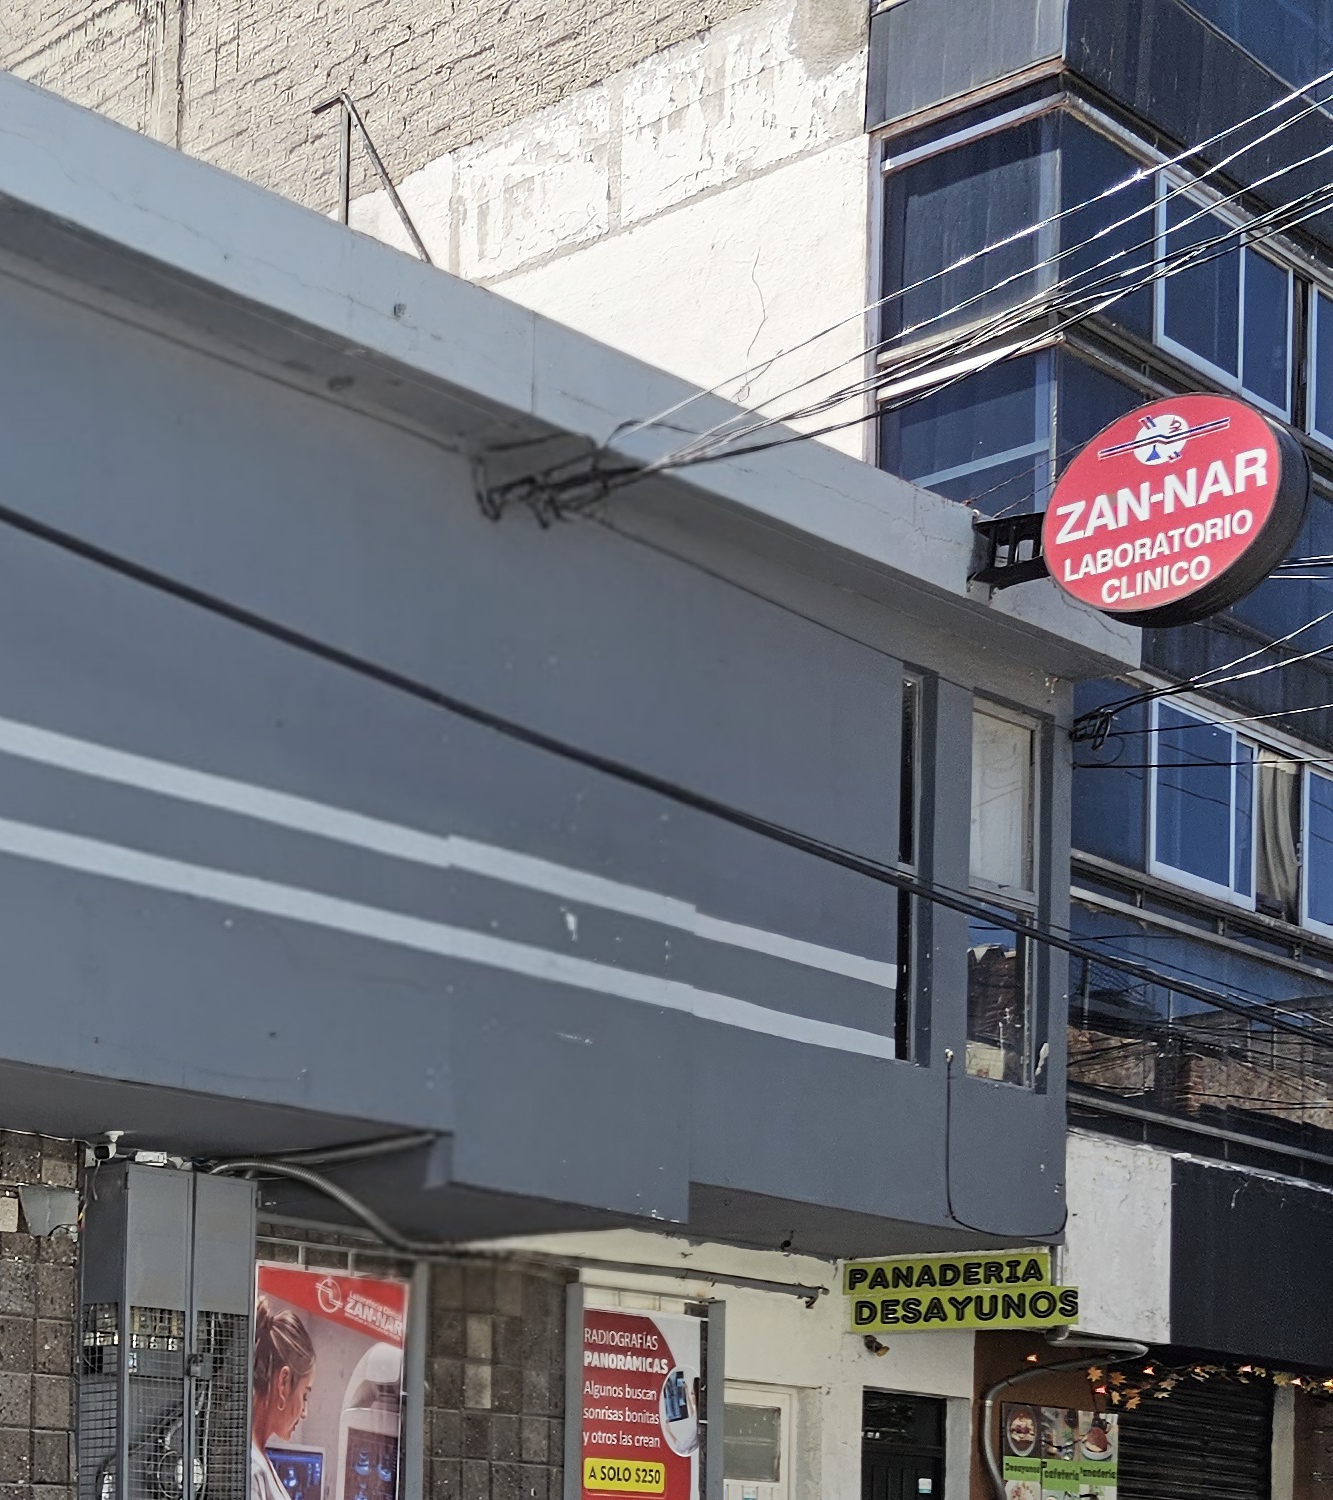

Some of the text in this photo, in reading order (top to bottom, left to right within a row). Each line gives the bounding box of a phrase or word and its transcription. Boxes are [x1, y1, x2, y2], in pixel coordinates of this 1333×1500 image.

[1055, 448, 1268, 545] ZAN-NAR
[1063, 509, 1253, 582] LABORATORIO
[1100, 555, 1211, 604] CLINICO
[848, 1258, 1044, 1291] PANADERIA
[854, 1289, 1079, 1325] DESAYUNOS
[584, 1327, 659, 1351] RADIOGRAFÍAS
[583, 1350, 669, 1375] PANORÁMICAS
[583, 1380, 657, 1401] Algunos buscan
[583, 1405, 660, 1425] sonrisas bonitas
[583, 1431, 661, 1448] y otros las crean
[588, 1466, 597, 1481] A
[600, 1466, 632, 1483] SOLO
